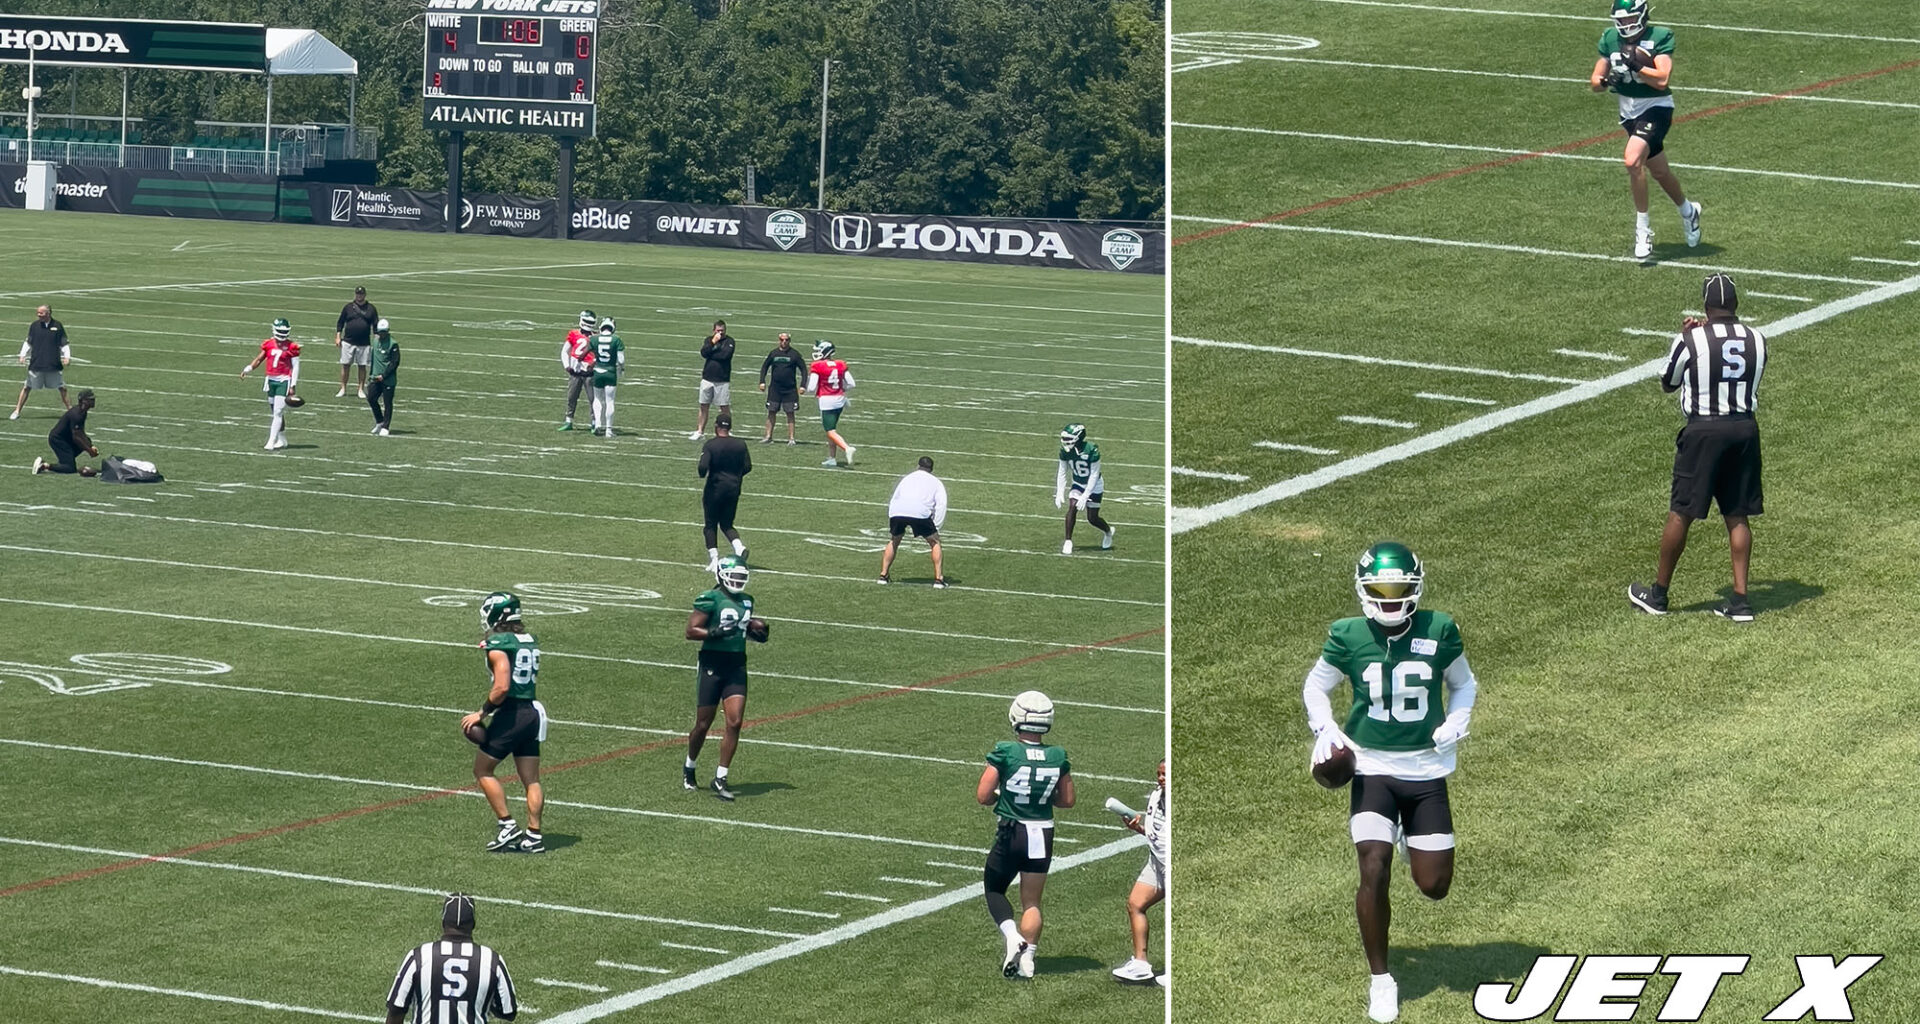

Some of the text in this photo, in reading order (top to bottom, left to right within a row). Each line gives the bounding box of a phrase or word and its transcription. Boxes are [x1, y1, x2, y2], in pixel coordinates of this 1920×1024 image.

[427, 0, 597, 14] NEW YORK JETS
[428, 15, 462, 28] WHITE
[502, 19, 539, 42] 1:06
[559, 19, 594, 33] GREEN
[0, 29, 130, 53] HONDA
[444, 32, 457, 52] 4
[576, 35, 590, 59] 0
[439, 57, 502, 73] DOWN TO GO
[512, 60, 575, 76] BALL ON QTR
[433, 72, 442, 87] 3
[576, 78, 585, 93] 2
[429, 105, 585, 128] ATLANTIC HEALTH
[356, 190, 392, 203] Atlantic
[356, 201, 421, 217] Health System
[476, 204, 541, 221] F.W. WEBB
[571, 206, 632, 231] etBlue
[489, 218, 526, 229] COMPANY
[656, 215, 741, 236] @NYJETS
[773, 227, 799, 235] CAMP
[877, 222, 1075, 260] HONDA
[1109, 246, 1136, 255] CAMP
[574, 337, 589, 356] 2
[597, 343, 611, 363] 5
[270, 348, 284, 369] 7
[1721, 339, 1746, 379] S
[827, 368, 840, 390] 4
[1068, 460, 1091, 478] 16
[1361, 660, 1433, 723] 16
[1005, 765, 1062, 806] 47
[442, 957, 469, 998] S
